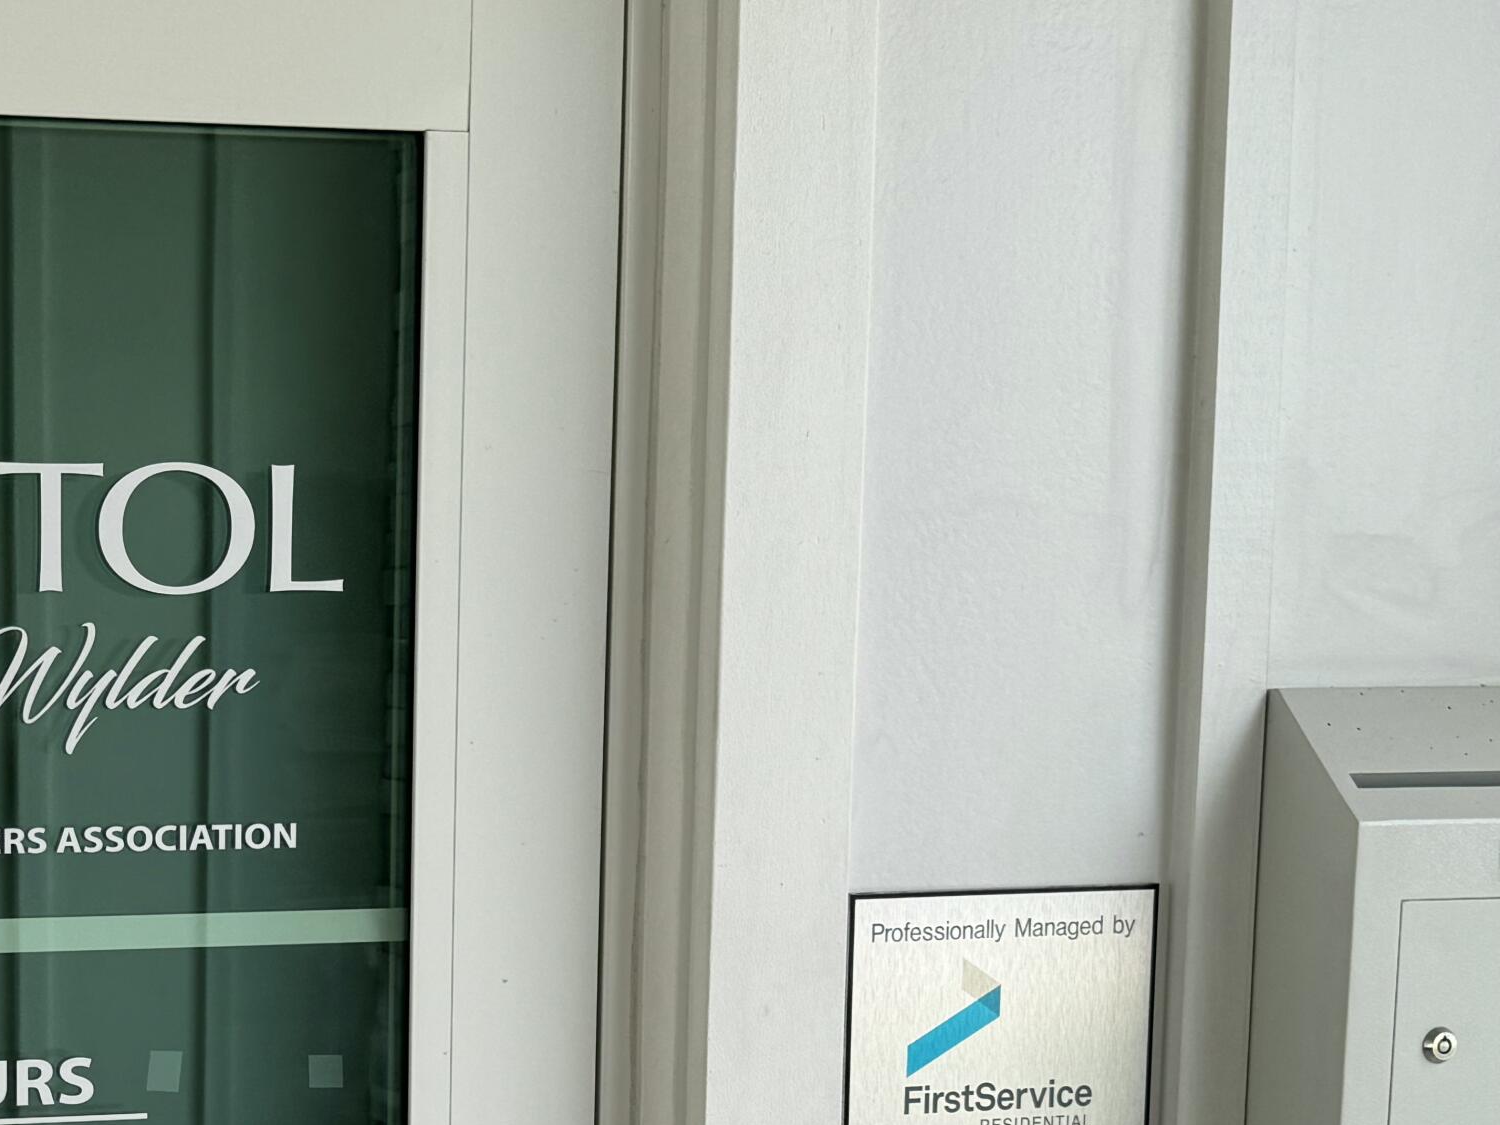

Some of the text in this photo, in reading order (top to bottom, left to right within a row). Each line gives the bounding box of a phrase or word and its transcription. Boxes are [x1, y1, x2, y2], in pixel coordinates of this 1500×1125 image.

[56, 822, 297, 854] ASSOCIATION
[871, 914, 1136, 944] Professionally Managed by
[903, 1078, 1093, 1116] FirstService
